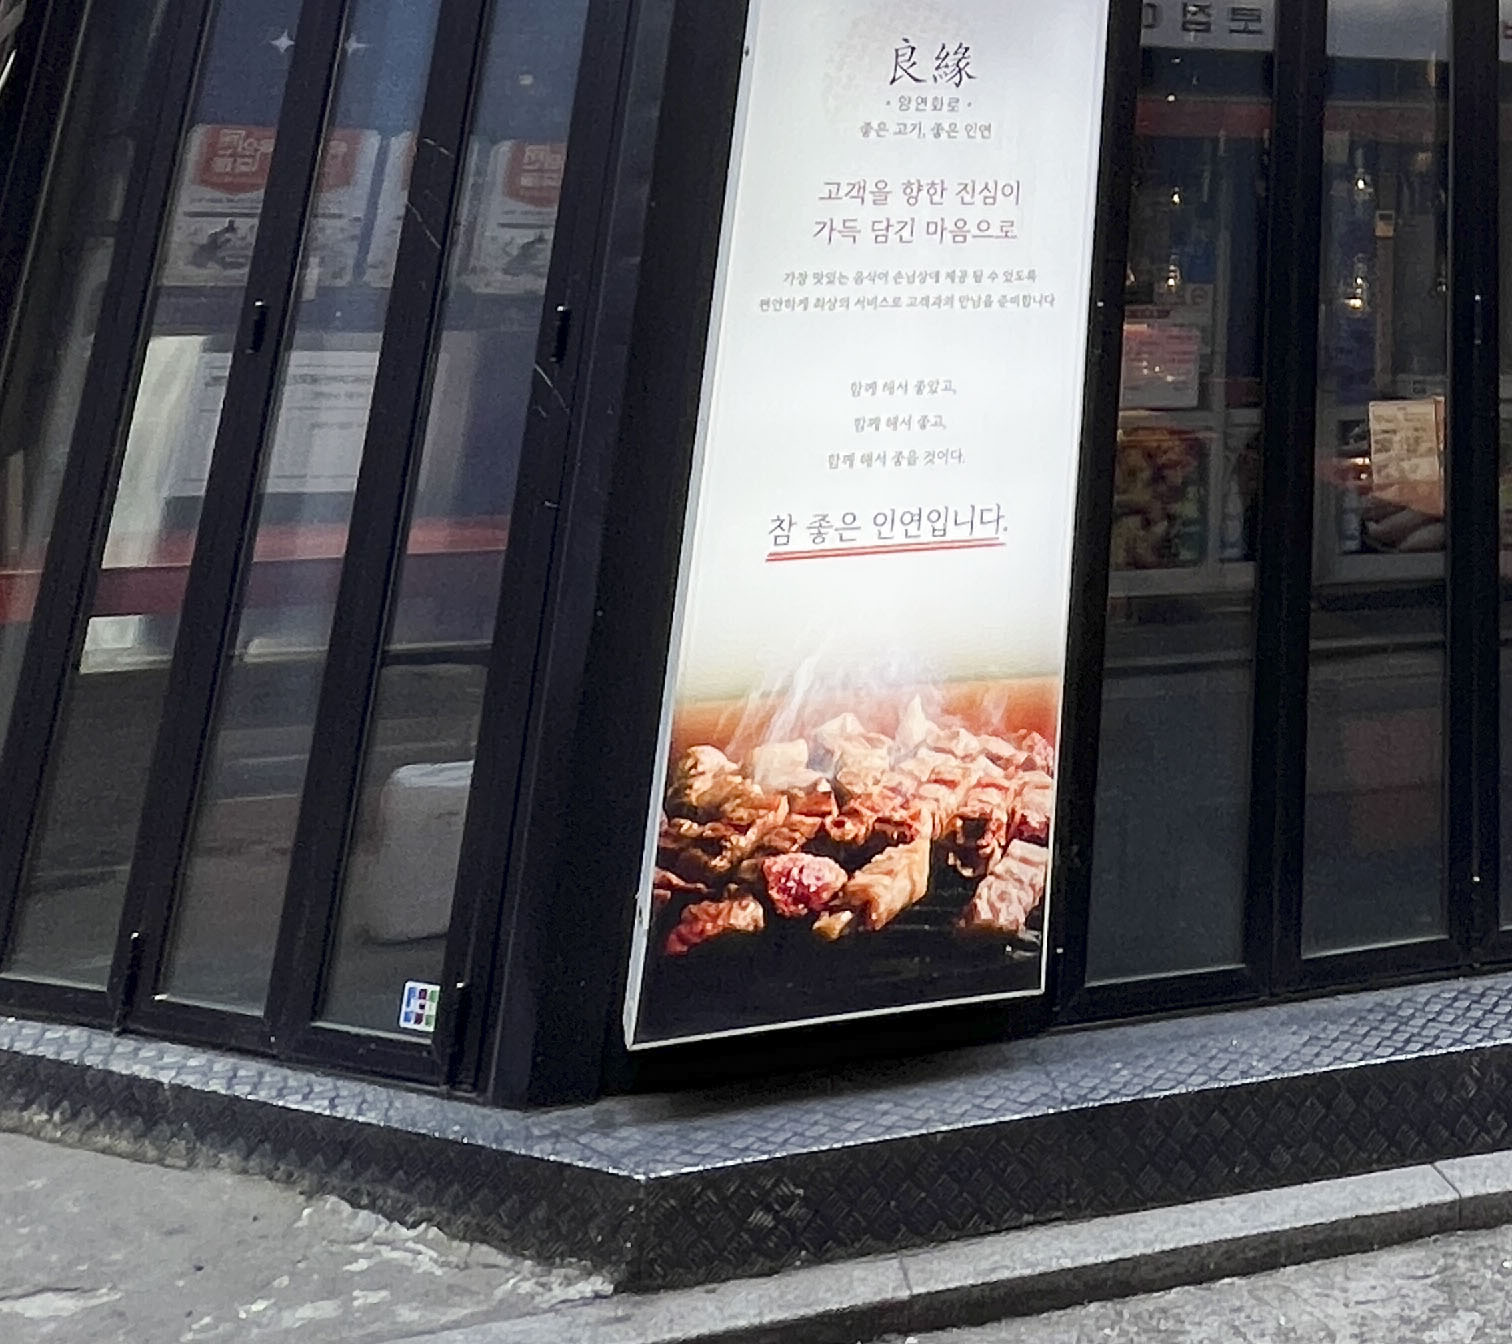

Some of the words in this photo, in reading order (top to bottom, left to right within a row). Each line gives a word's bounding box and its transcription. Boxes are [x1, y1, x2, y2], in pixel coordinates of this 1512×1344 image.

[888, 37, 978, 88] 良緣
[817, 179, 893, 207] 고객을
[901, 179, 948, 207] 향한
[955, 179, 1022, 206] 진심이
[812, 216, 862, 245] 가득
[870, 216, 917, 245] 담긴
[925, 216, 1018, 245] 마음으로
[767, 512, 797, 547] 참
[804, 512, 863, 545] 좋은
[872, 502, 1009, 541] 인연입니다.
